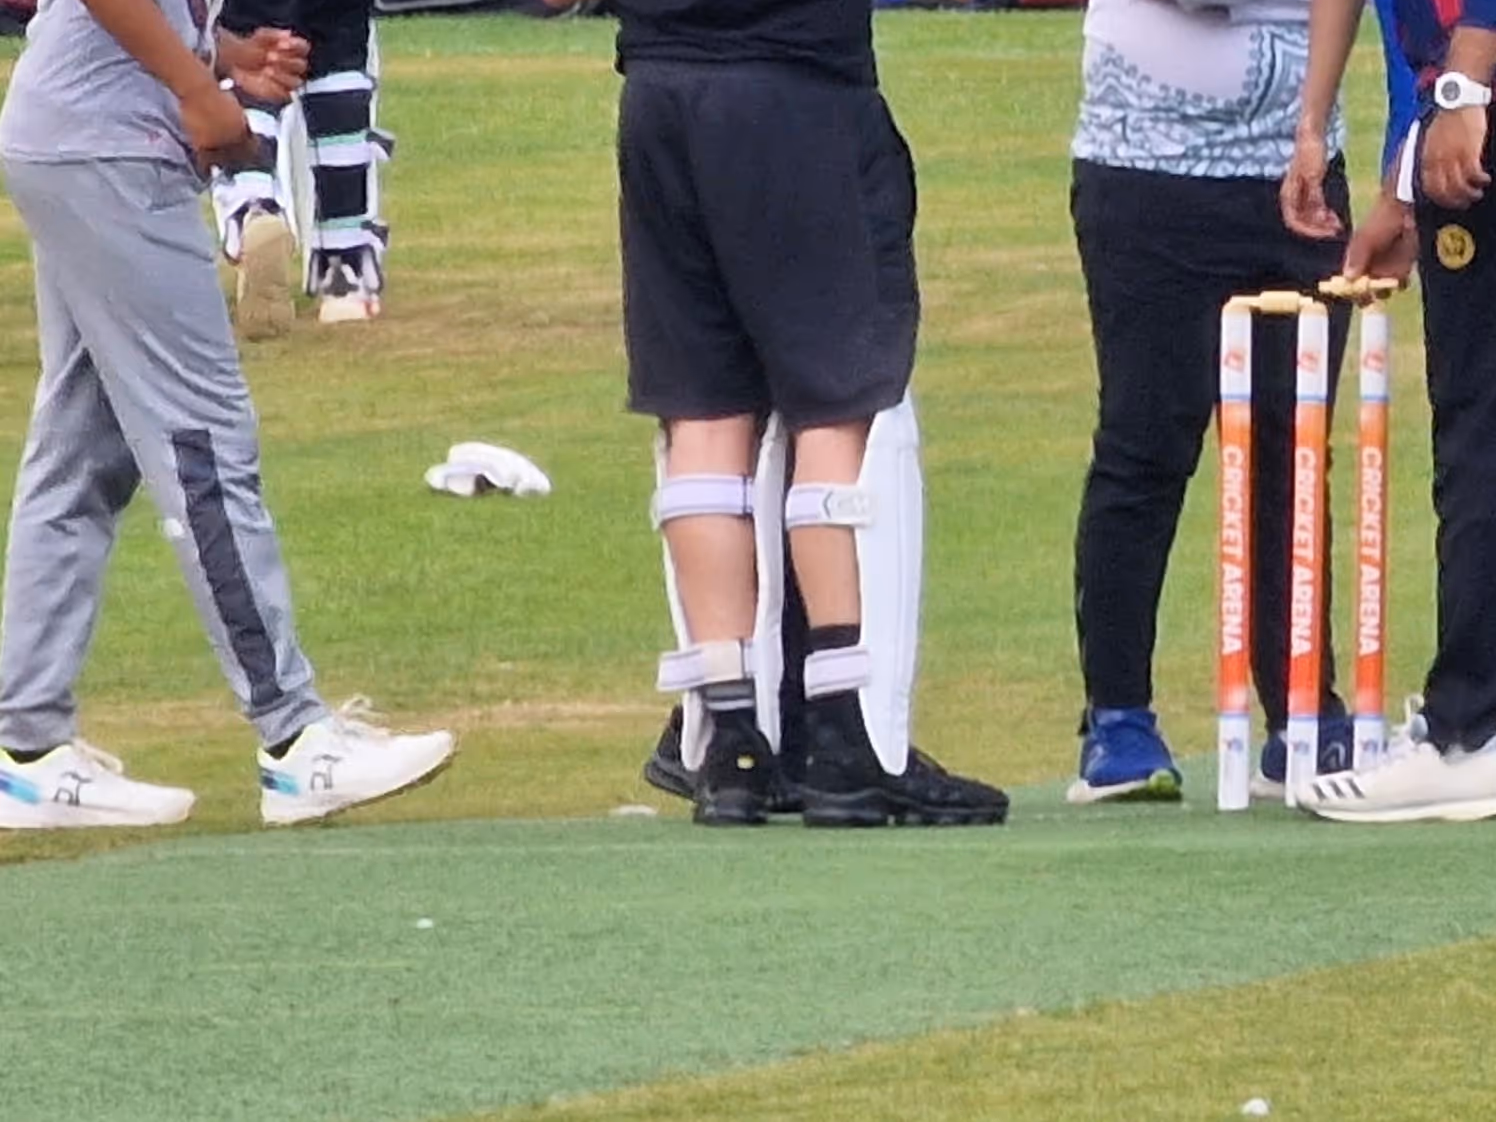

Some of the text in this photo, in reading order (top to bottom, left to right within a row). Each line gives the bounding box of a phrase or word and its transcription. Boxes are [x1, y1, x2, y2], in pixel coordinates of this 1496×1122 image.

[1221, 444, 1244, 656] CRICKET ARENA
[1290, 445, 1316, 658] CRICKET ARENA
[1358, 446, 1383, 656] CRICKET ARENA
